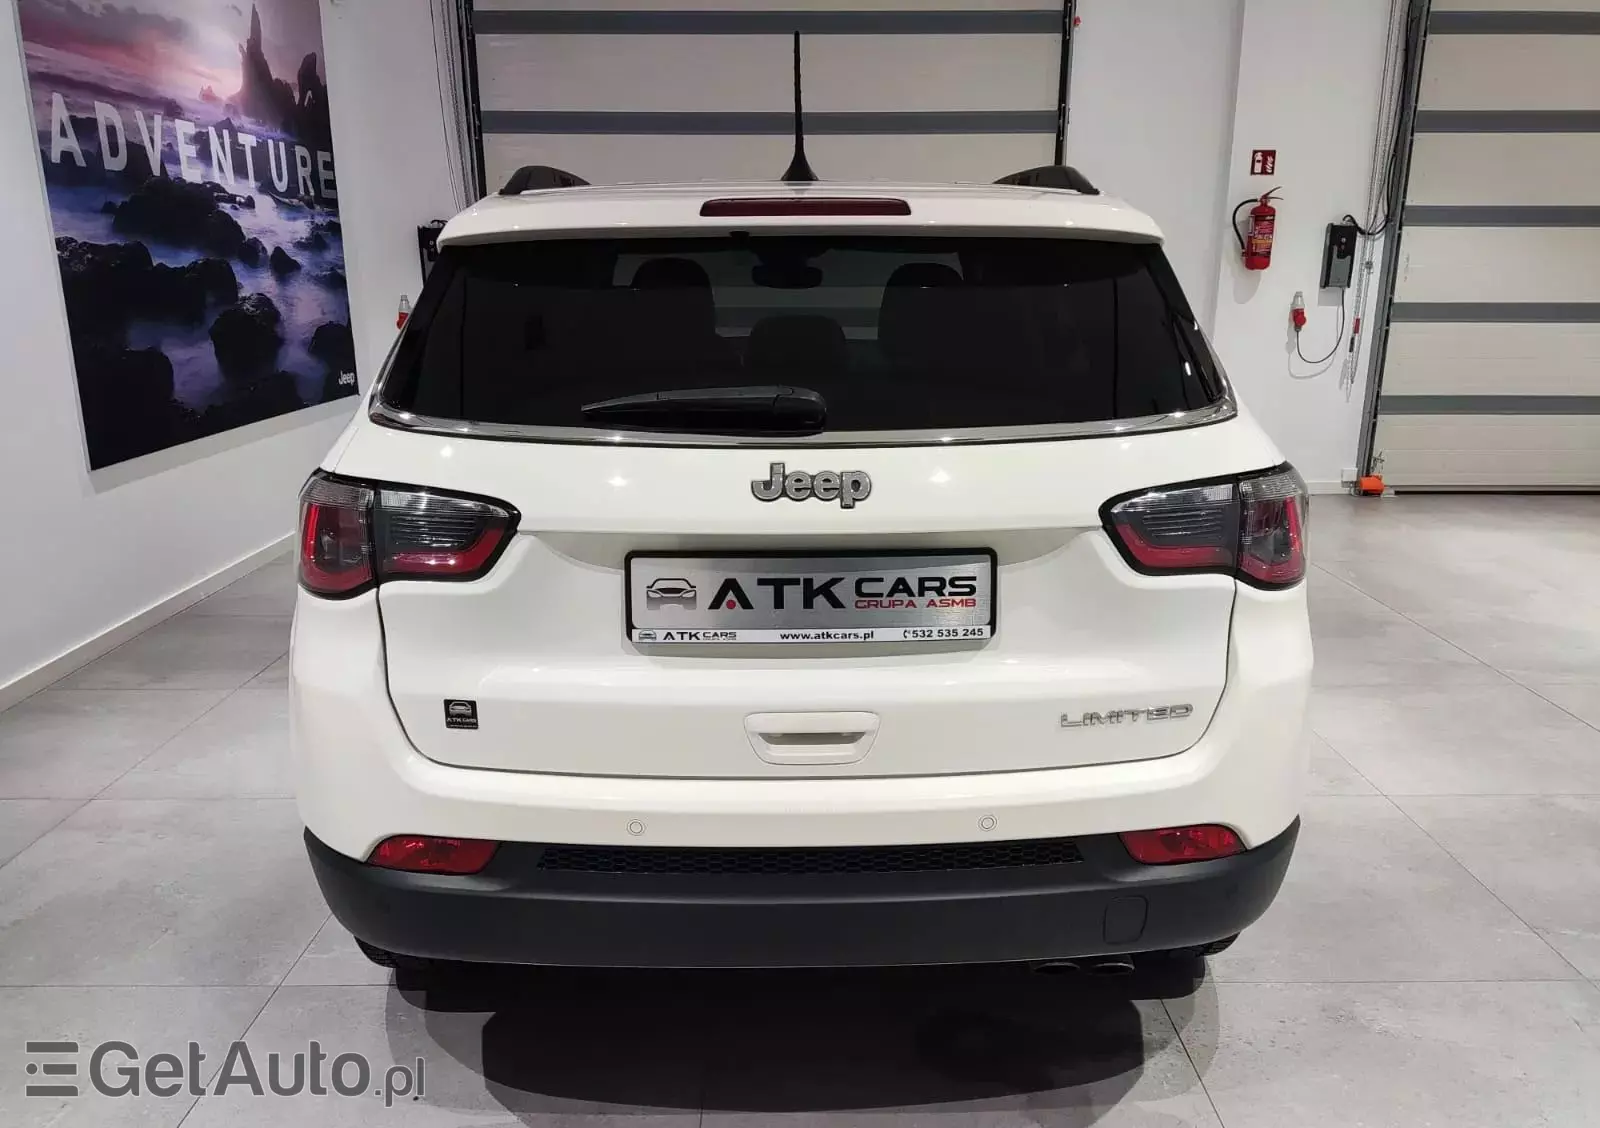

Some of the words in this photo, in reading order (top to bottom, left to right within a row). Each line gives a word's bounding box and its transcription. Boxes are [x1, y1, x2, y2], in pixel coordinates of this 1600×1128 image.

[50, 91, 338, 199] ADVENTURE
[338, 370, 355, 386] Jeep
[751, 462, 872, 509] Jeep
[707, 577, 846, 610] ATK
[855, 576, 977, 598] CARS
[854, 599, 917, 609] GRUPA
[926, 598, 977, 608] ASMB
[662, 631, 700, 641] ATK
[702, 631, 737, 639] CARS
[779, 629, 875, 641] www.atkcars.pl
[911, 629, 936, 639] 532
[937, 628, 959, 638] 535
[962, 628, 984, 638] 245
[1060, 703, 1194, 728] LIMITED
